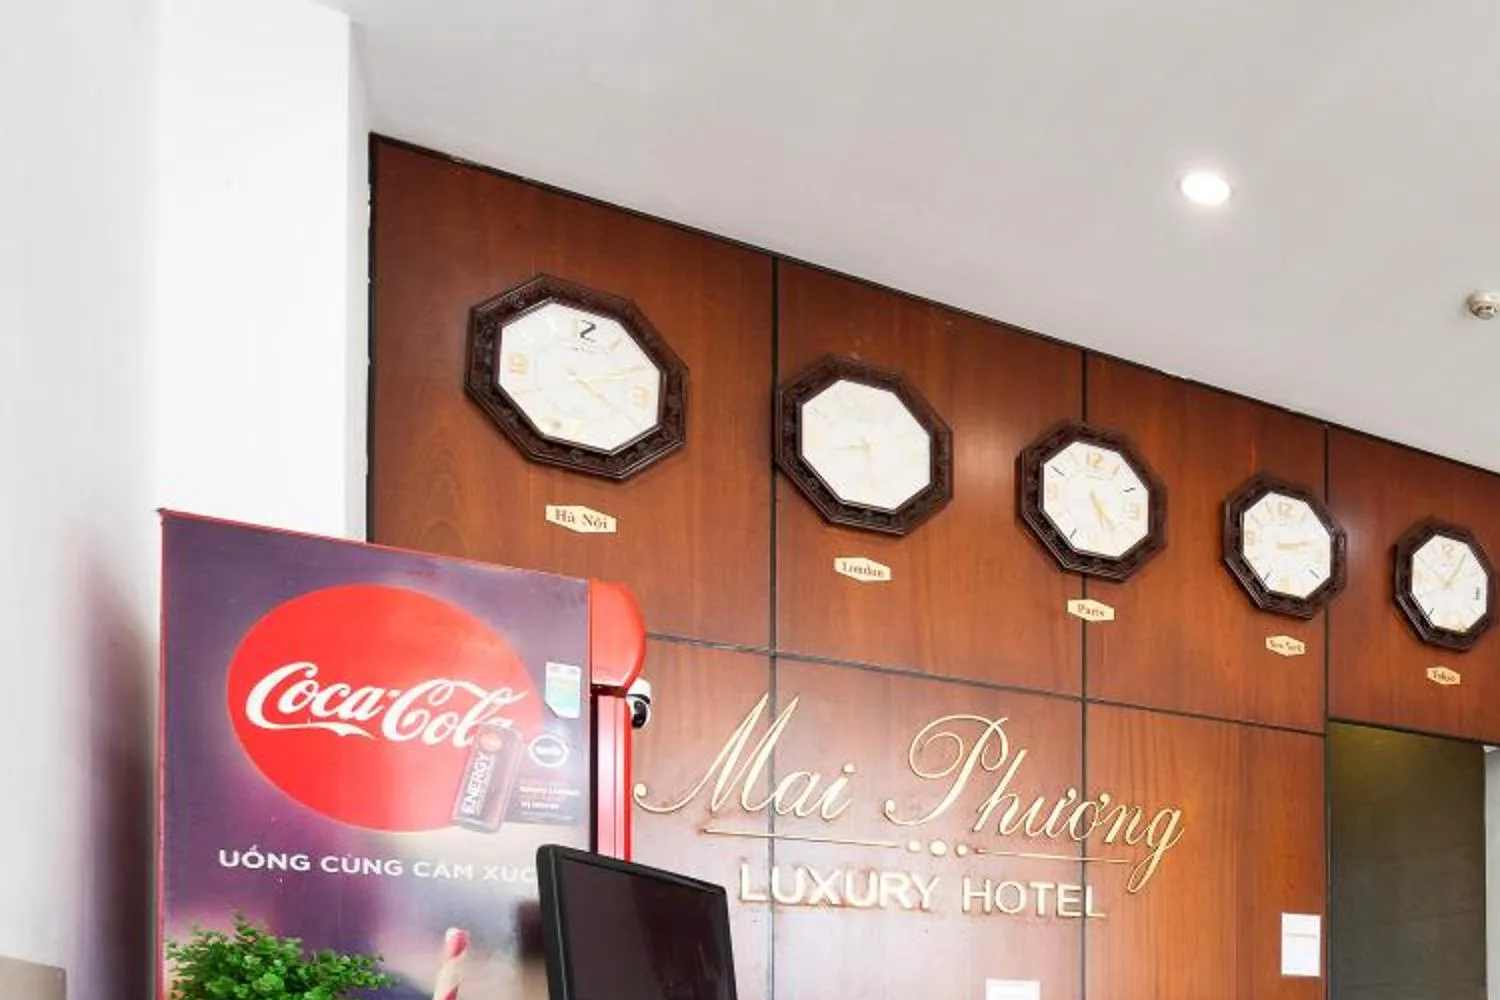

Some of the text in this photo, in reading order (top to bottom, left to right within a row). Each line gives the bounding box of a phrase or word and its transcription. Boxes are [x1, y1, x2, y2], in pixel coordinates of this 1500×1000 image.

[555, 508, 575, 524] Hà
[1077, 603, 1105, 617] Paris
[245, 661, 528, 747] Coca-Col
[461, 751, 489, 815] ENERGY
[633, 693, 1185, 894] Mai Phương
[739, 862, 1107, 918] LUXURY HOTEL
